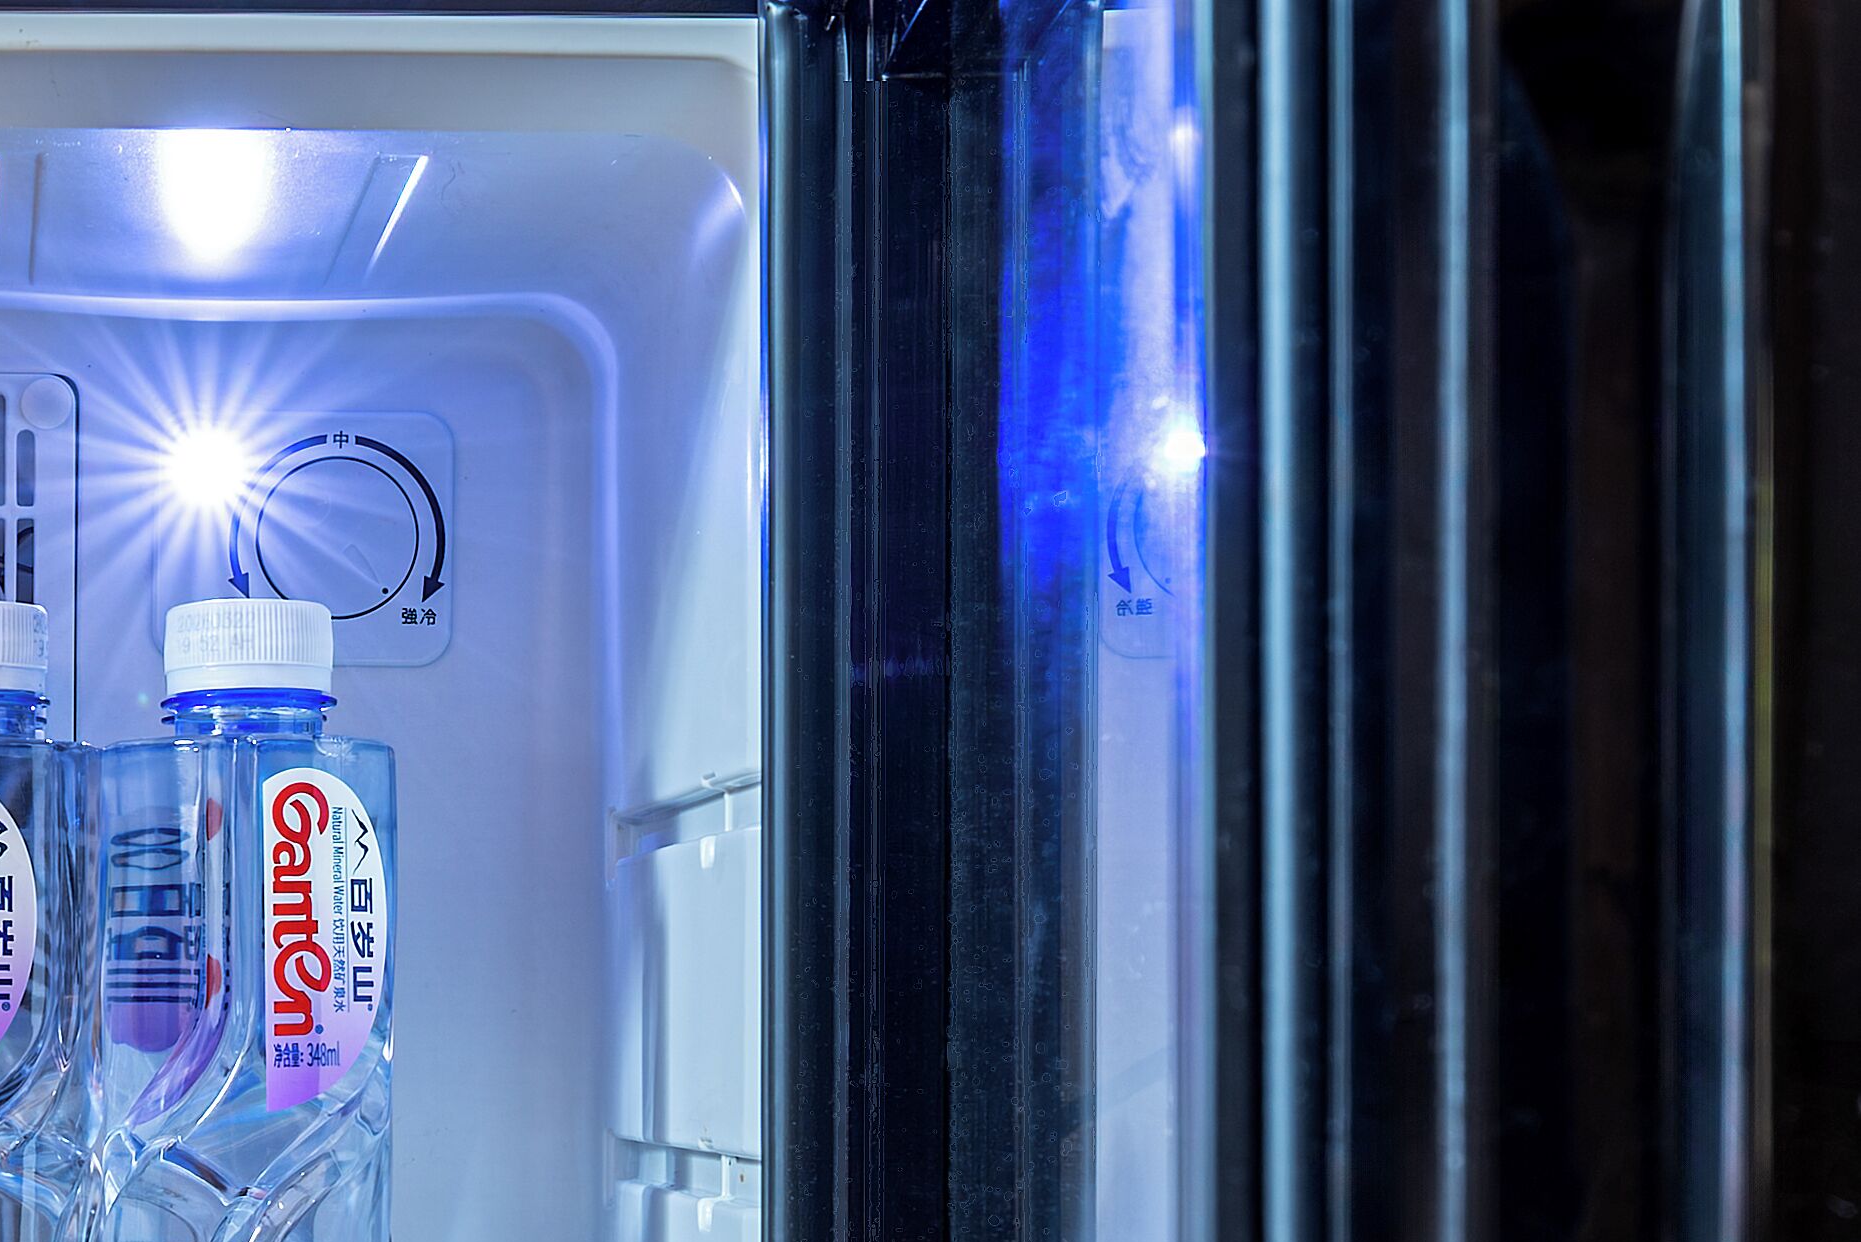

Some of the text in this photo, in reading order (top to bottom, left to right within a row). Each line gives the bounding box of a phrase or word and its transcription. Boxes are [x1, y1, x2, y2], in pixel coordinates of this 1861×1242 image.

[333, 430, 350, 449] 中
[331, 807, 345, 844] Natural
[331, 846, 345, 885] Mineral
[272, 782, 332, 1037] Ganten
[331, 886, 345, 915] Water
[349, 877, 375, 1003] 百岁山
[307, 1040, 340, 1067] 348ml
